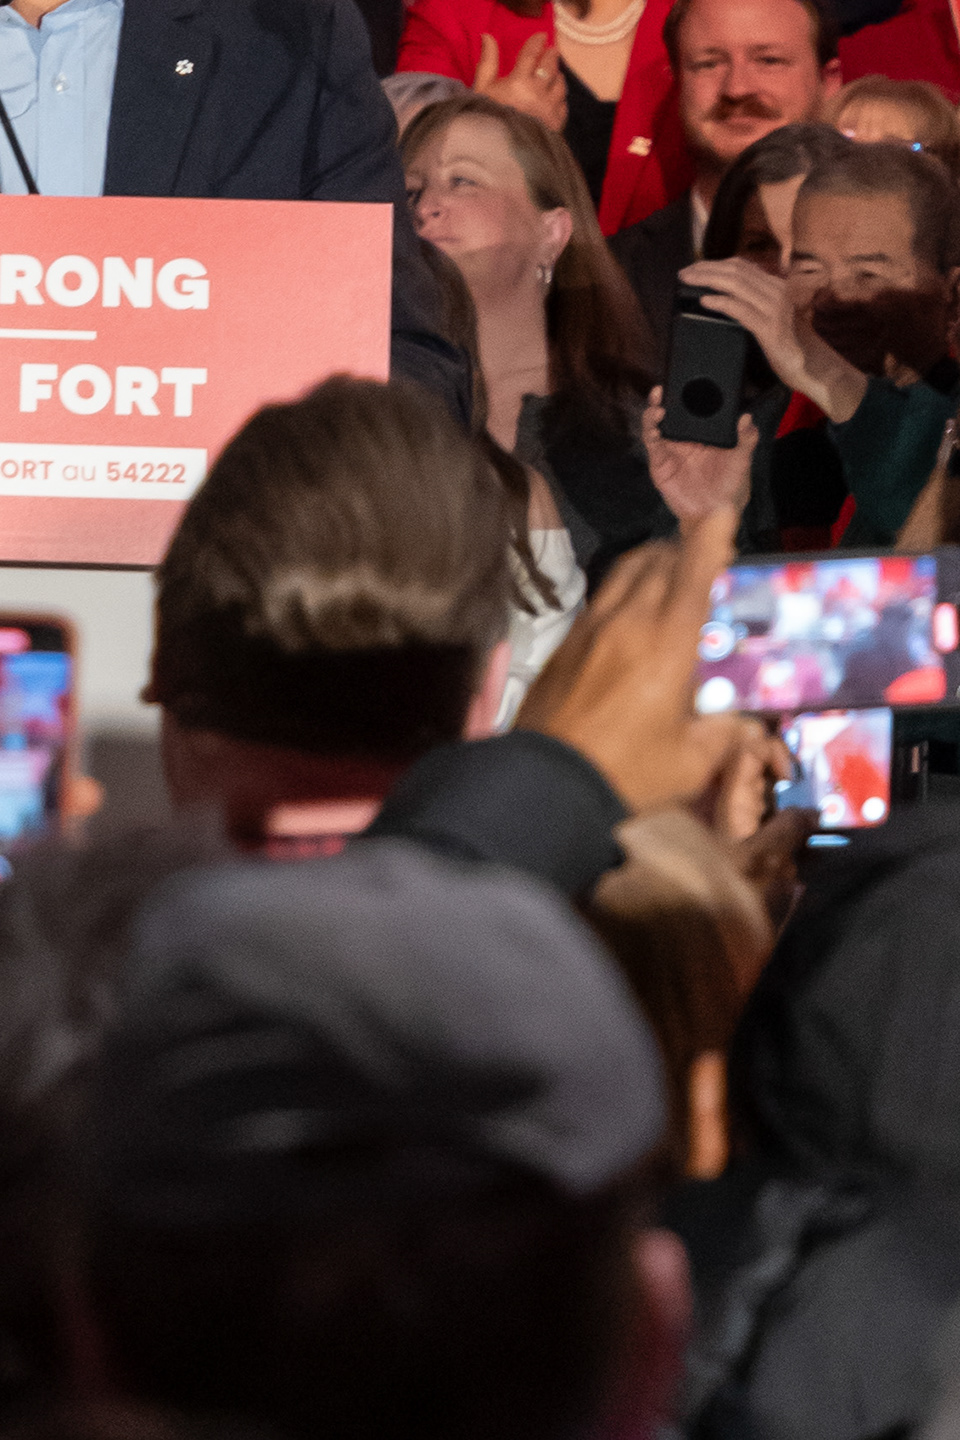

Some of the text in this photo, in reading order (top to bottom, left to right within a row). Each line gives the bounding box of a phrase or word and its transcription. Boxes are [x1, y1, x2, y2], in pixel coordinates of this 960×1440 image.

[19, 363, 208, 418] FORT
[62, 463, 96, 481] au
[107, 461, 186, 483] 54222
